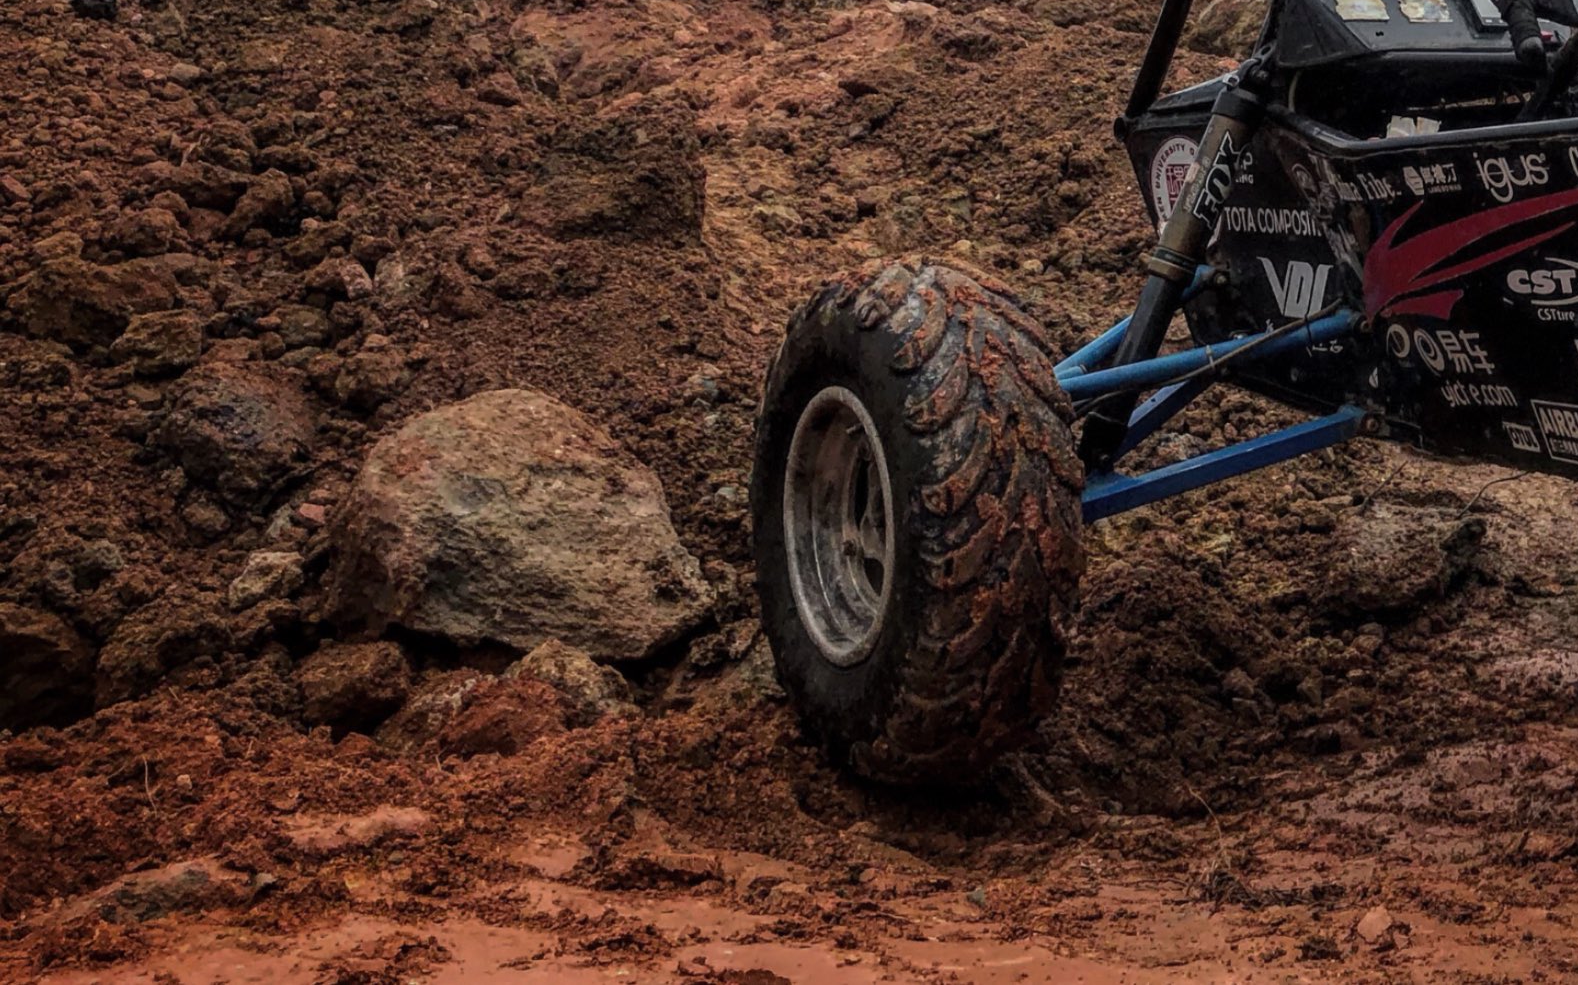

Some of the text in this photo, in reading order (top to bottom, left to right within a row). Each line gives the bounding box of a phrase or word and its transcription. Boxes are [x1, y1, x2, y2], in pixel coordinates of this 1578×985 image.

[1193, 130, 1240, 230] FOX
[1357, 172, 1402, 201] Fibe
[1472, 151, 1550, 203] igus
[1224, 206, 1323, 237] TOTA COMPOSIT
[1506, 269, 1577, 295] CST
